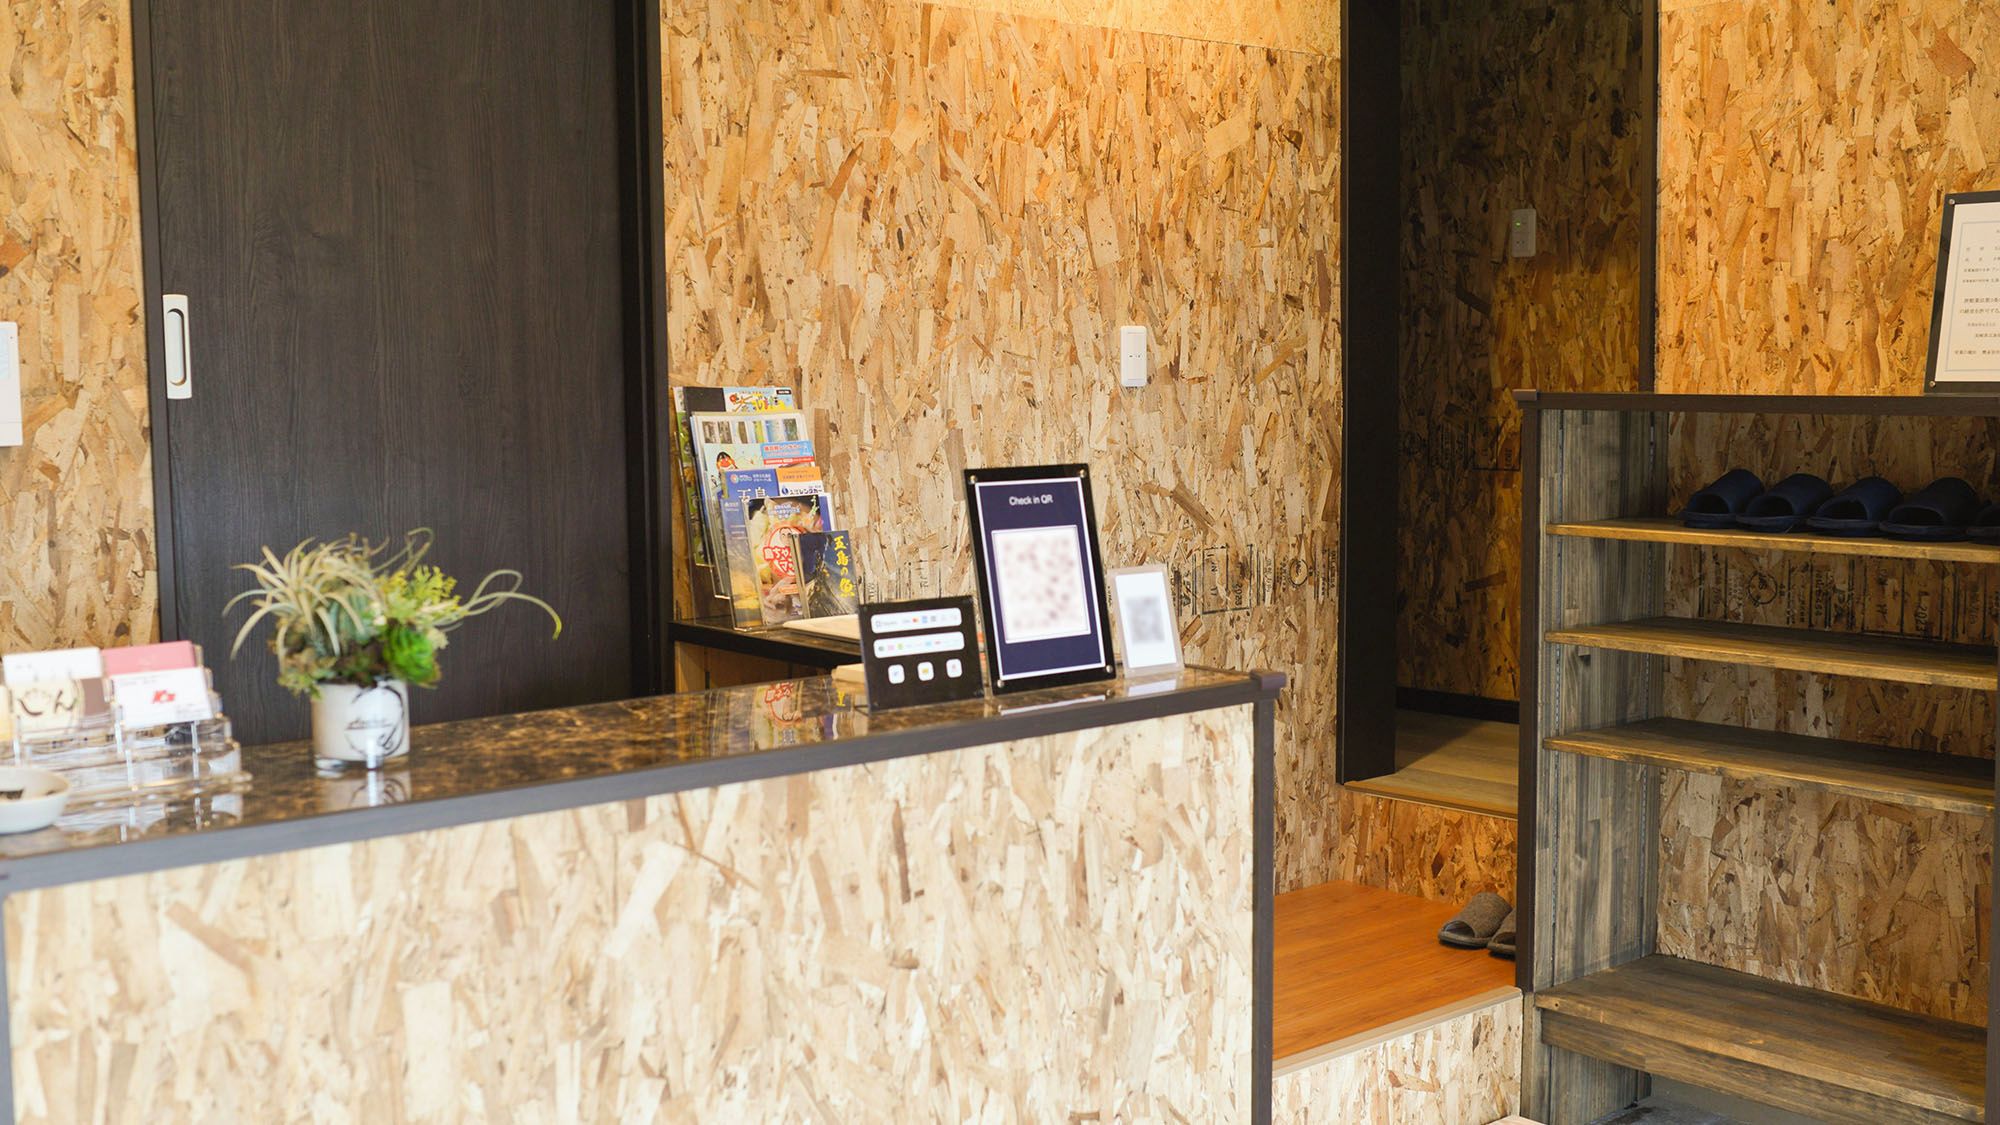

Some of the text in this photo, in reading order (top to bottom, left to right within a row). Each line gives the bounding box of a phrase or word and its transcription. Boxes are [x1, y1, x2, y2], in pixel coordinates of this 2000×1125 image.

[1009, 494, 1054, 506] Check in QR
